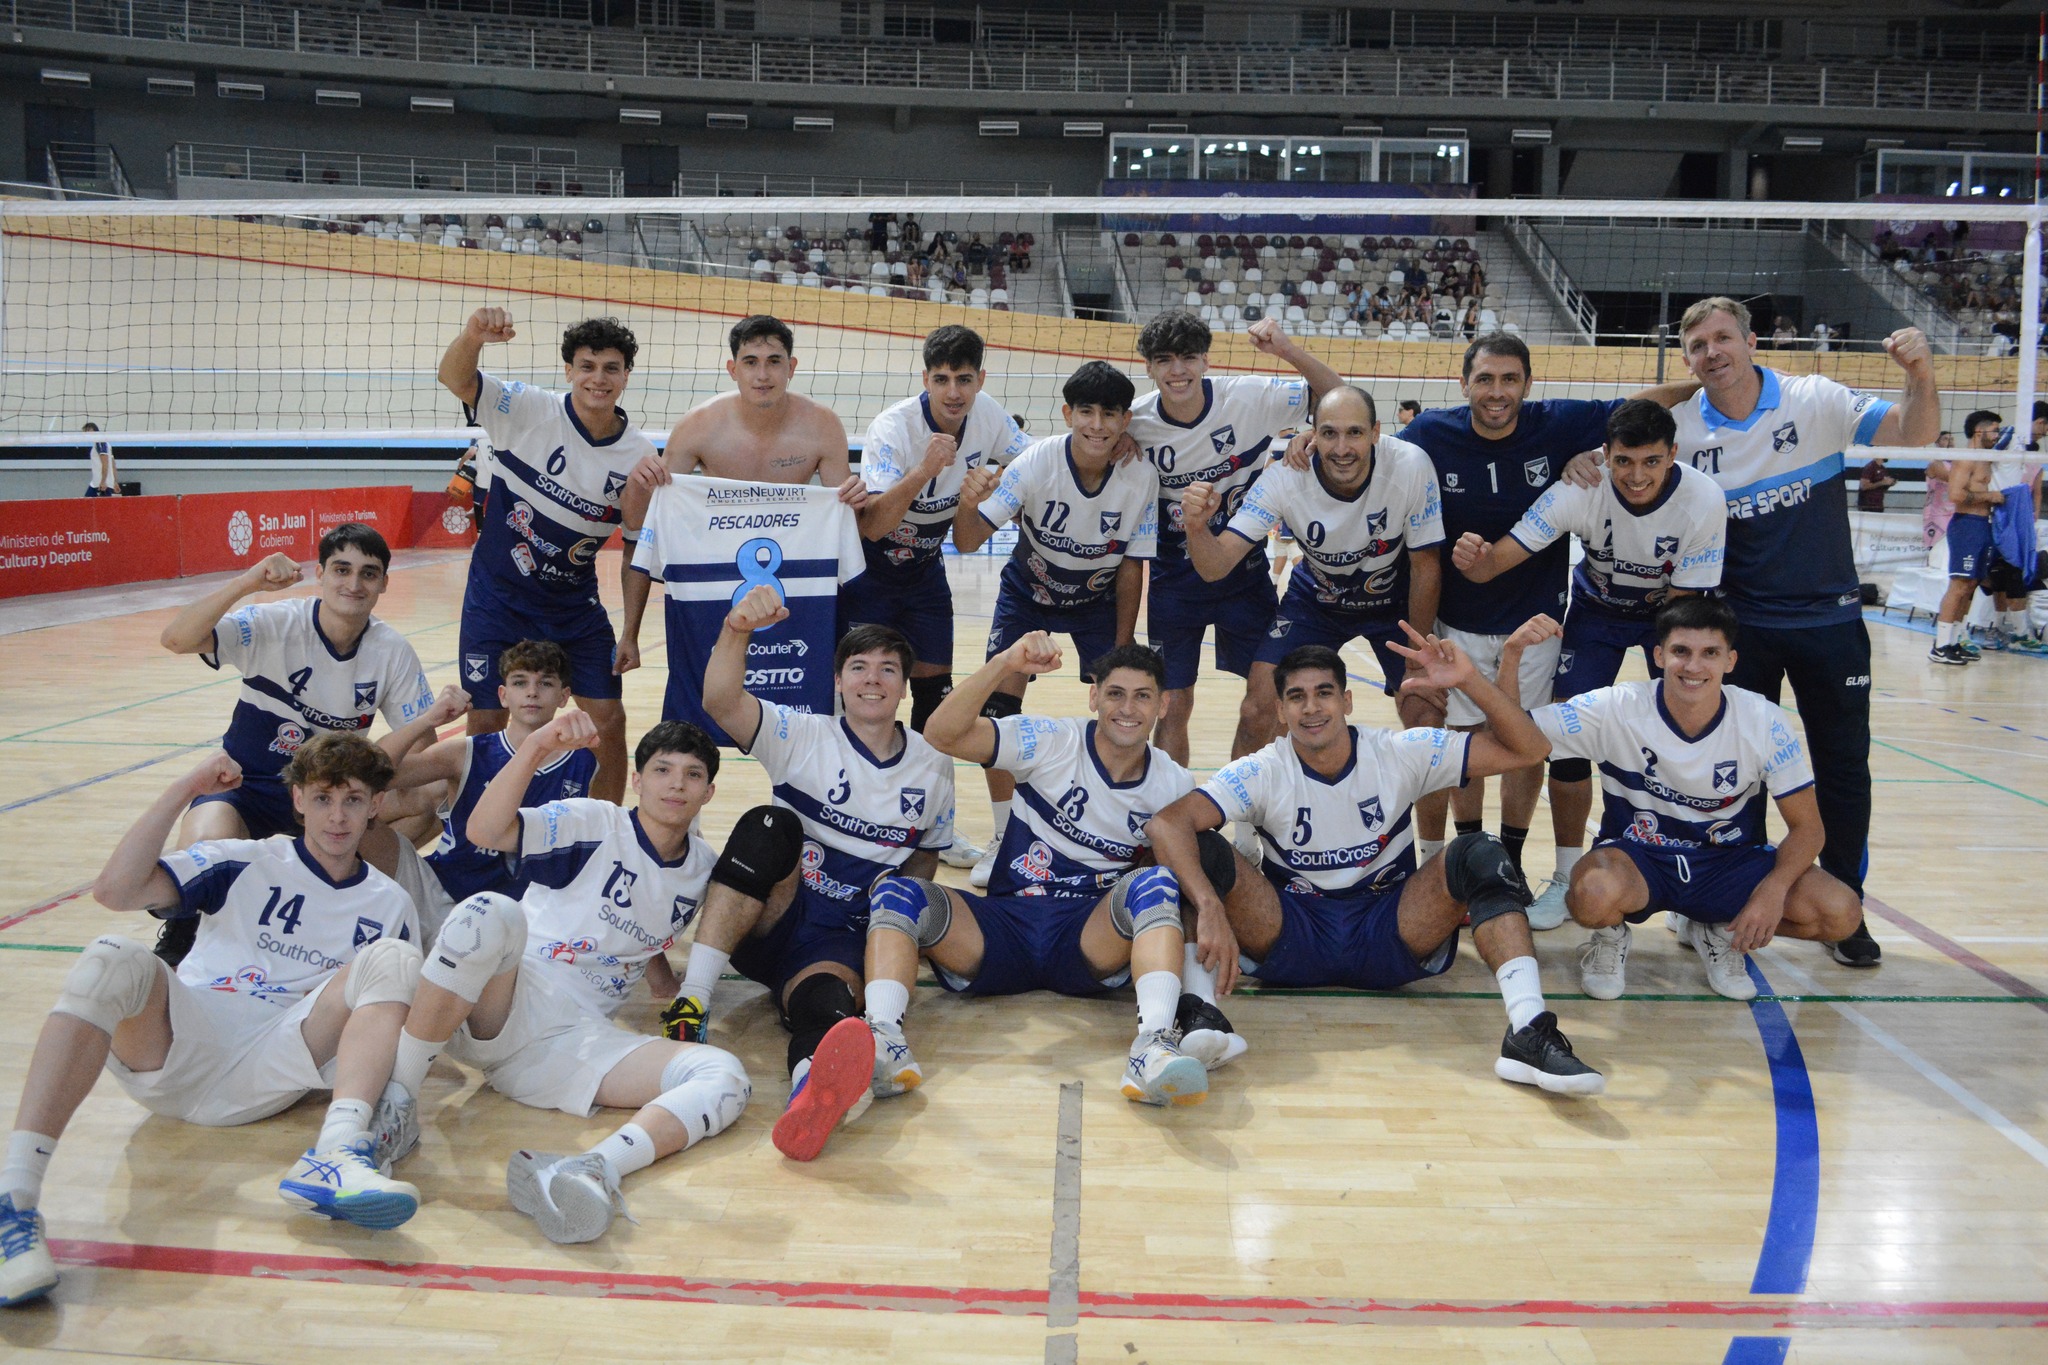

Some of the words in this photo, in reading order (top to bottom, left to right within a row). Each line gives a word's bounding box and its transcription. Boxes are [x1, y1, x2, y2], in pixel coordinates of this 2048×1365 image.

[546, 445, 567, 476] 6
[1145, 445, 1176, 473] 10
[1692, 446, 1723, 475] CT
[1487, 462, 1498, 493] 1
[535, 474, 605, 518] SouthCross
[1756, 477, 1811, 515] SPORT
[259, 514, 279, 531] San
[281, 513, 306, 530] Juan
[319, 512, 347, 522] Ministerio
[347, 512, 354, 521] de
[355, 510, 378, 521] Turismo,
[709, 513, 800, 531] PESCADORES
[1040, 500, 1071, 533] 12
[52, 531, 65, 544] de
[66, 530, 111, 544] Turismo,
[260, 534, 294, 548] Gobierno
[1040, 531, 1108, 555] SouthCross
[1306, 521, 1326, 548] 9
[0, 553, 38, 569] Cultura
[40, 556, 47, 568] y
[50, 549, 92, 565] Deporte
[288, 666, 314, 696] 4
[1641, 747, 1658, 777] 2
[827, 768, 852, 805] 3
[1056, 780, 1089, 822] 13
[820, 805, 907, 842] SouthCross
[1052, 813, 1135, 858] SouthCross
[1292, 807, 1313, 846] 5
[1291, 842, 1380, 865] SouthCross
[602, 861, 638, 908] 15
[258, 886, 305, 935] 14
